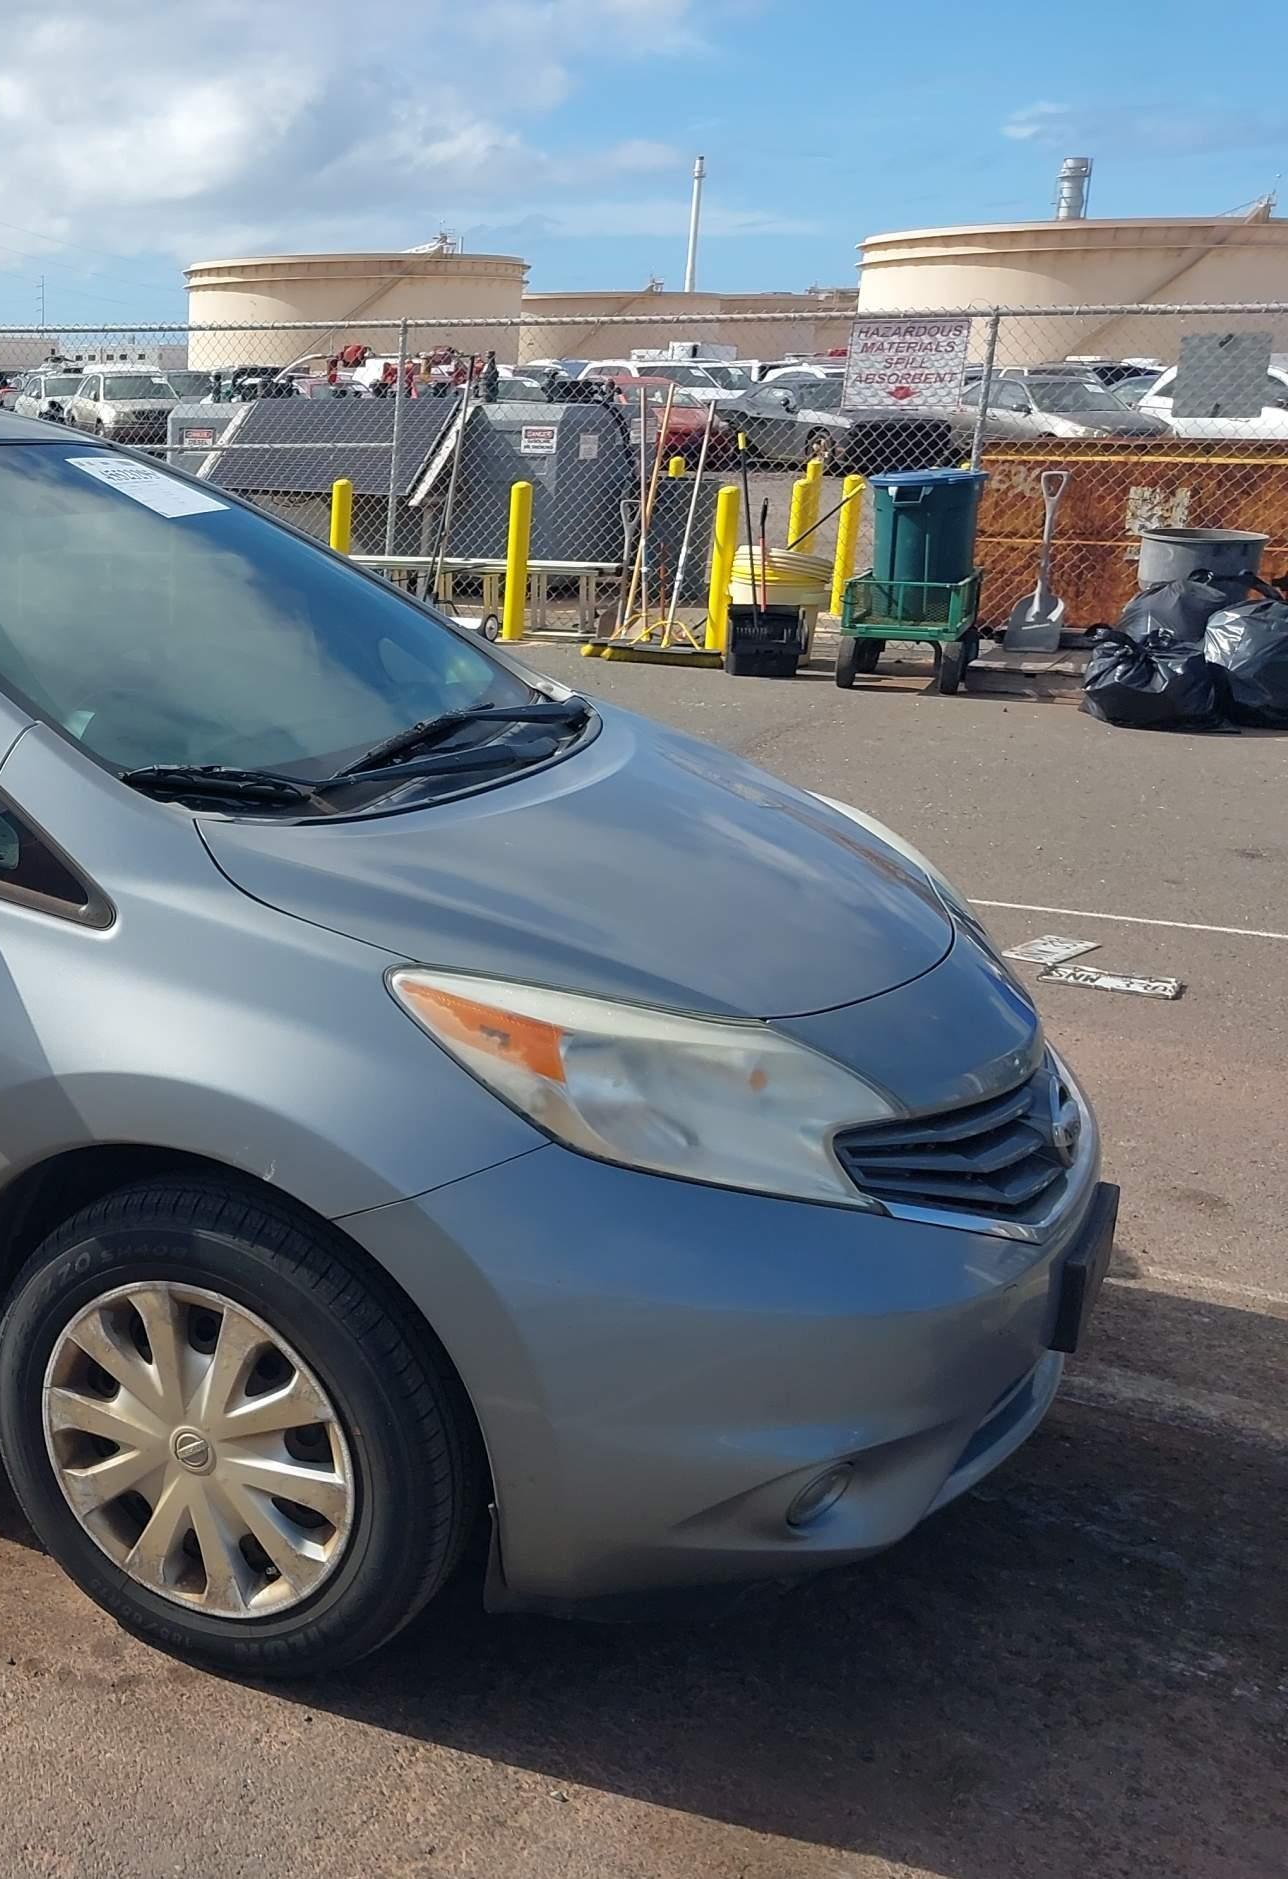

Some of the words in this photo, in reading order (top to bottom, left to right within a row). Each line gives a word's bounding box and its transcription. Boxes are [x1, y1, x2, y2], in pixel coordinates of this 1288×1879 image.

[857, 325, 964, 338] HAZARDOUS
[860, 341, 956, 353] MATERIALS
[883, 357, 930, 369] SPILL
[853, 373, 959, 385] ABSORBENT
